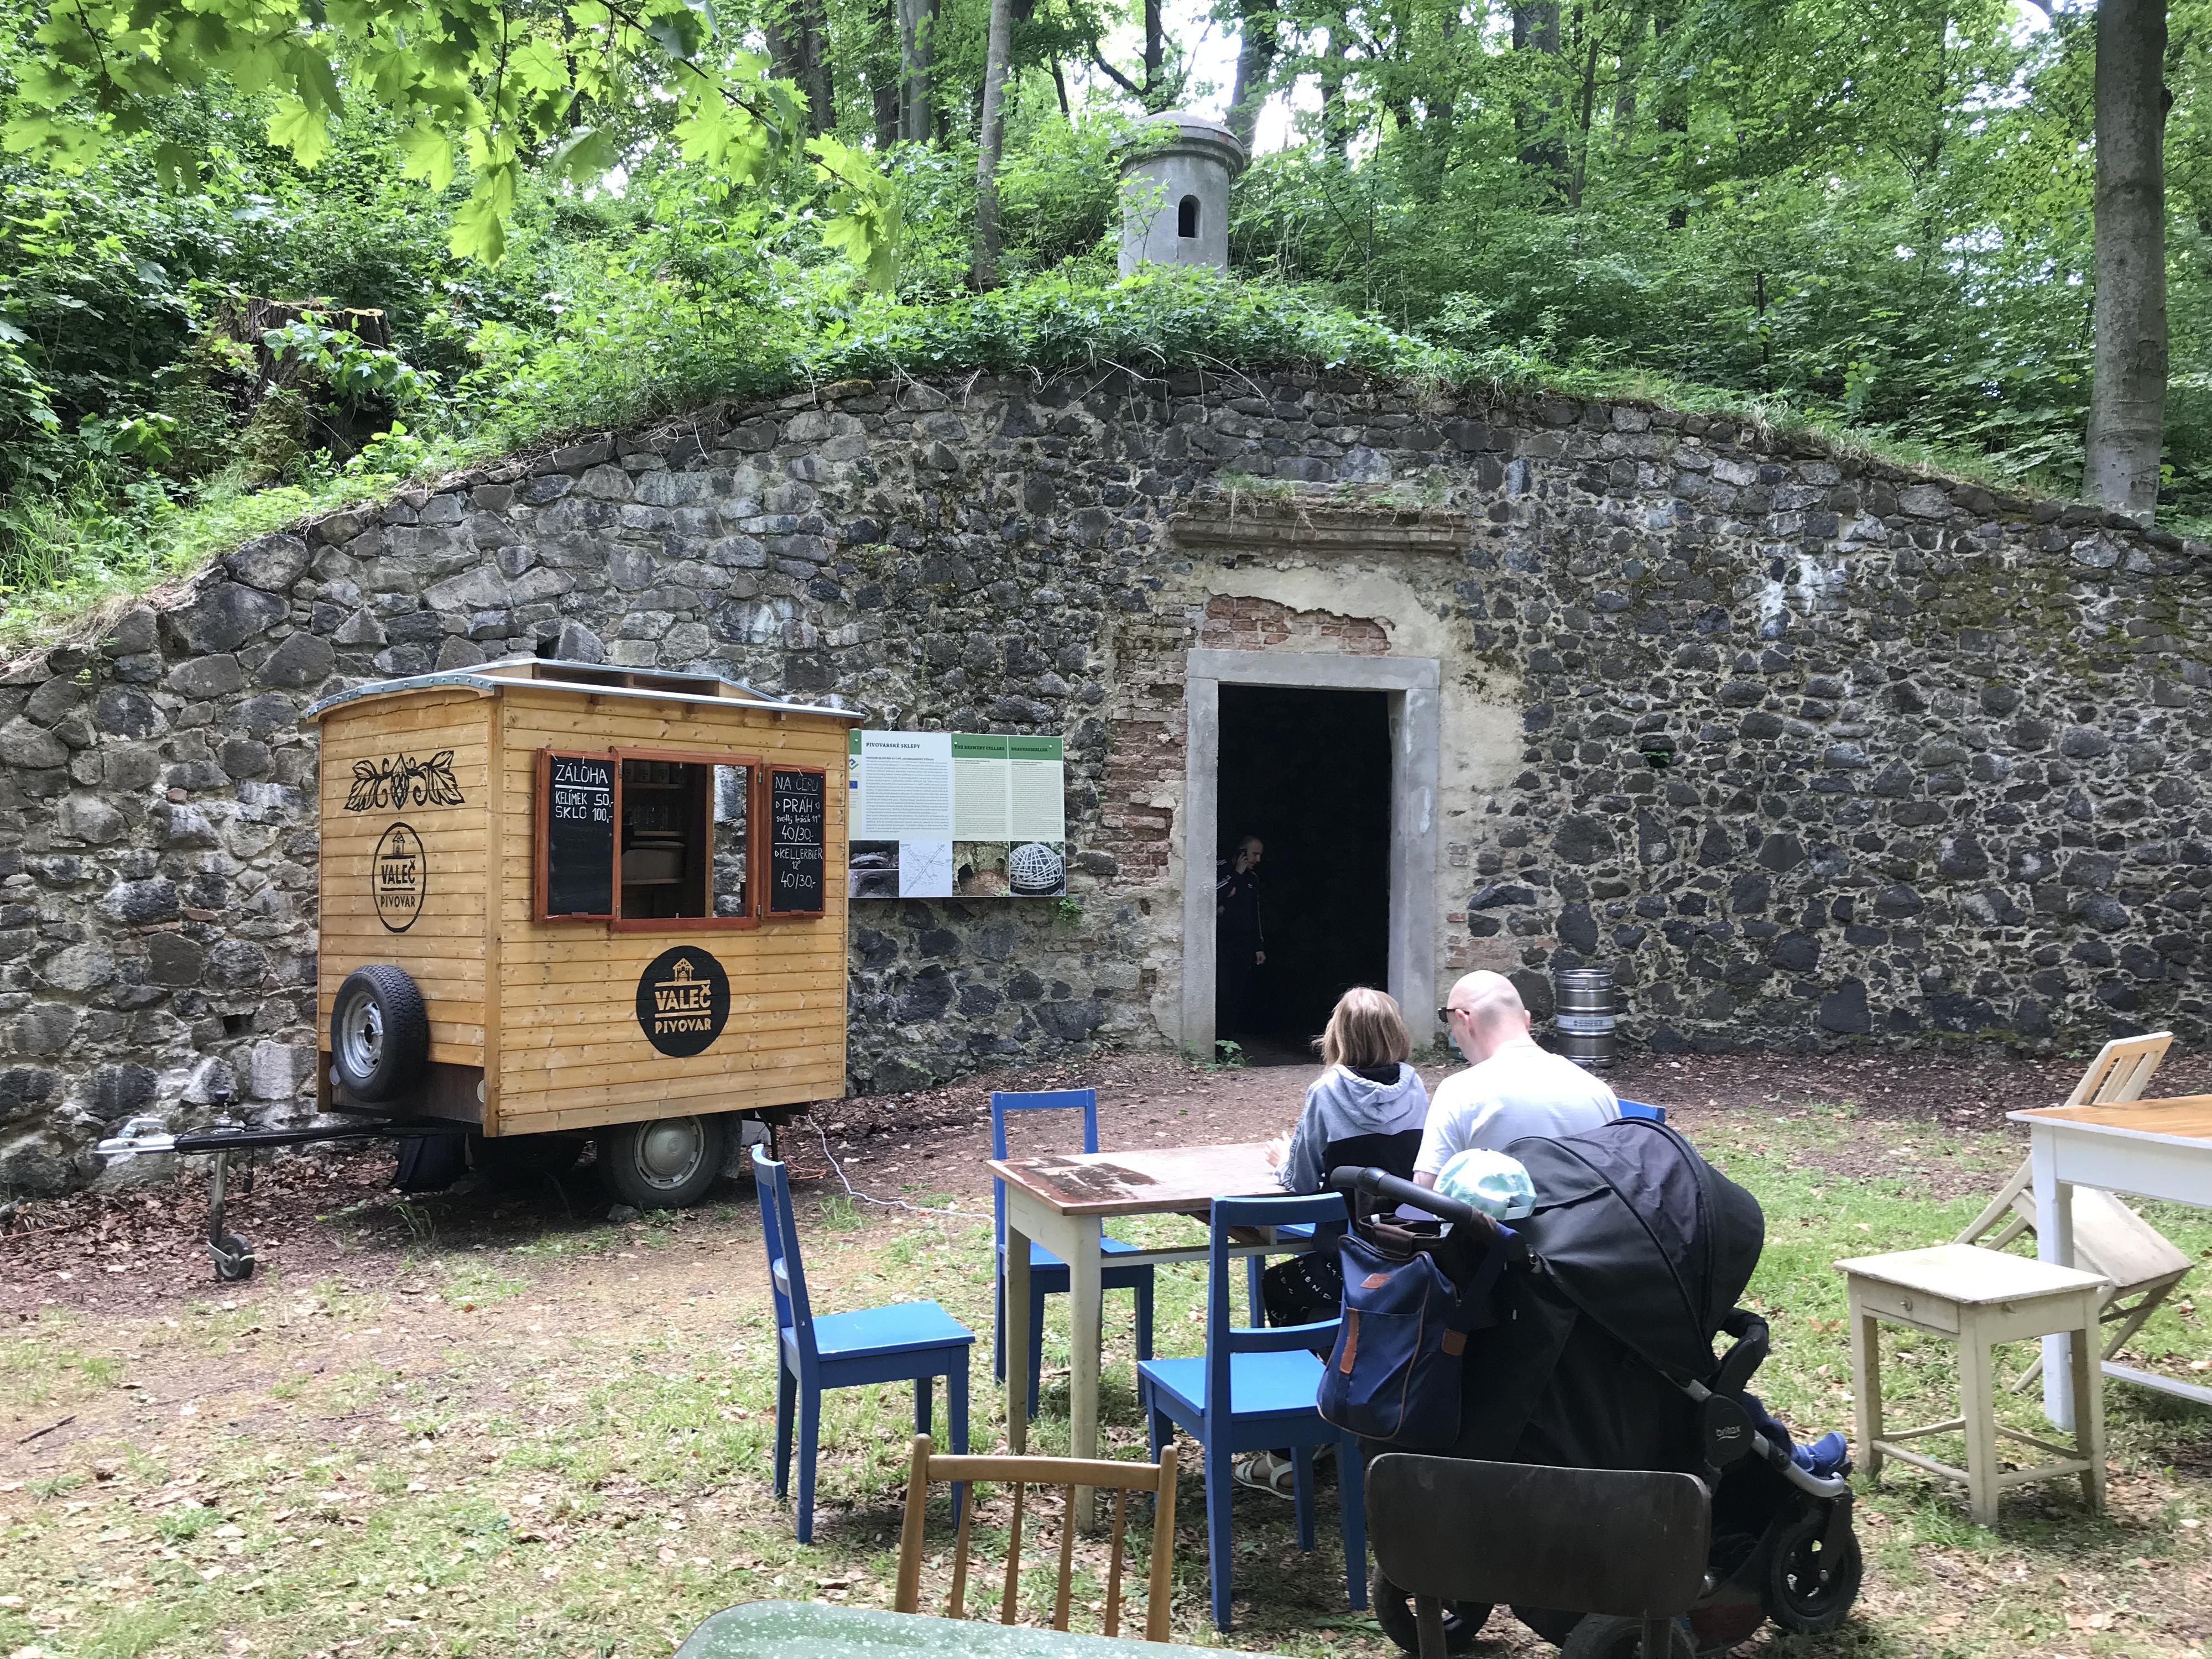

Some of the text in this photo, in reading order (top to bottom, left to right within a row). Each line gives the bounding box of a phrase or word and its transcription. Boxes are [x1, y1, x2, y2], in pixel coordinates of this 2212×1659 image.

[555, 763, 608, 784] ZÁLOHA
[775, 776, 792, 790] NA
[555, 789, 614, 807] KELÍMEK 50,-
[783, 796, 813, 813] PRÁH
[555, 806, 613, 823] SKLO 100,-
[781, 825, 813, 842] 40/30,-
[779, 848, 823, 859] KELLERBIER
[381, 859, 416, 884] VALEČ
[781, 871, 816, 889] 40/30,-
[380, 896, 415, 907] PIVOVAR
[655, 984, 712, 1011] VALEČ
[655, 1018, 712, 1034] PIVOVAR
